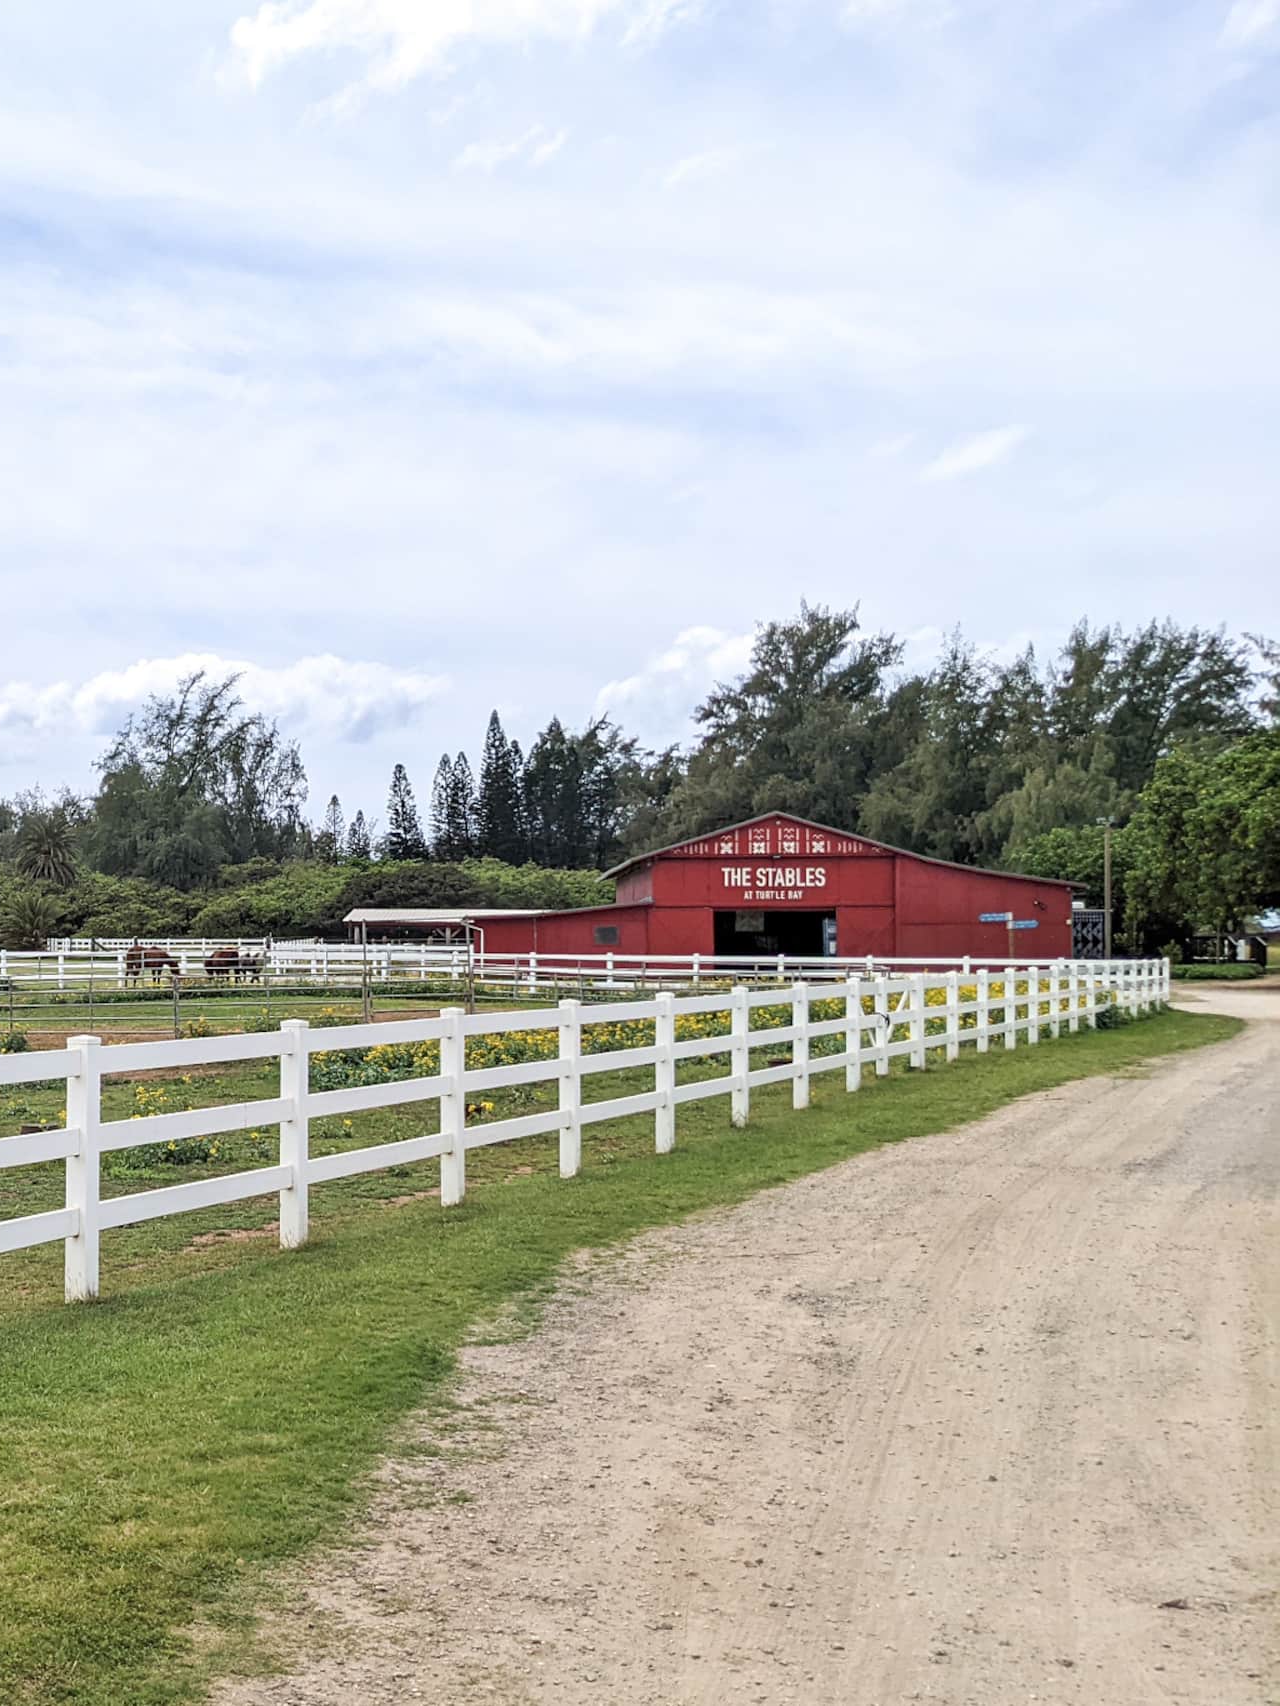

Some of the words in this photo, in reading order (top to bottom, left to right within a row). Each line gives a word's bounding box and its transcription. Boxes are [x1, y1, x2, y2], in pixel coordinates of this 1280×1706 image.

[721, 867, 752, 887] THE
[755, 867, 826, 887] STABLES
[743, 890, 753, 900] AT
[755, 890, 786, 900] TURTLE
[788, 890, 803, 900] BAY
